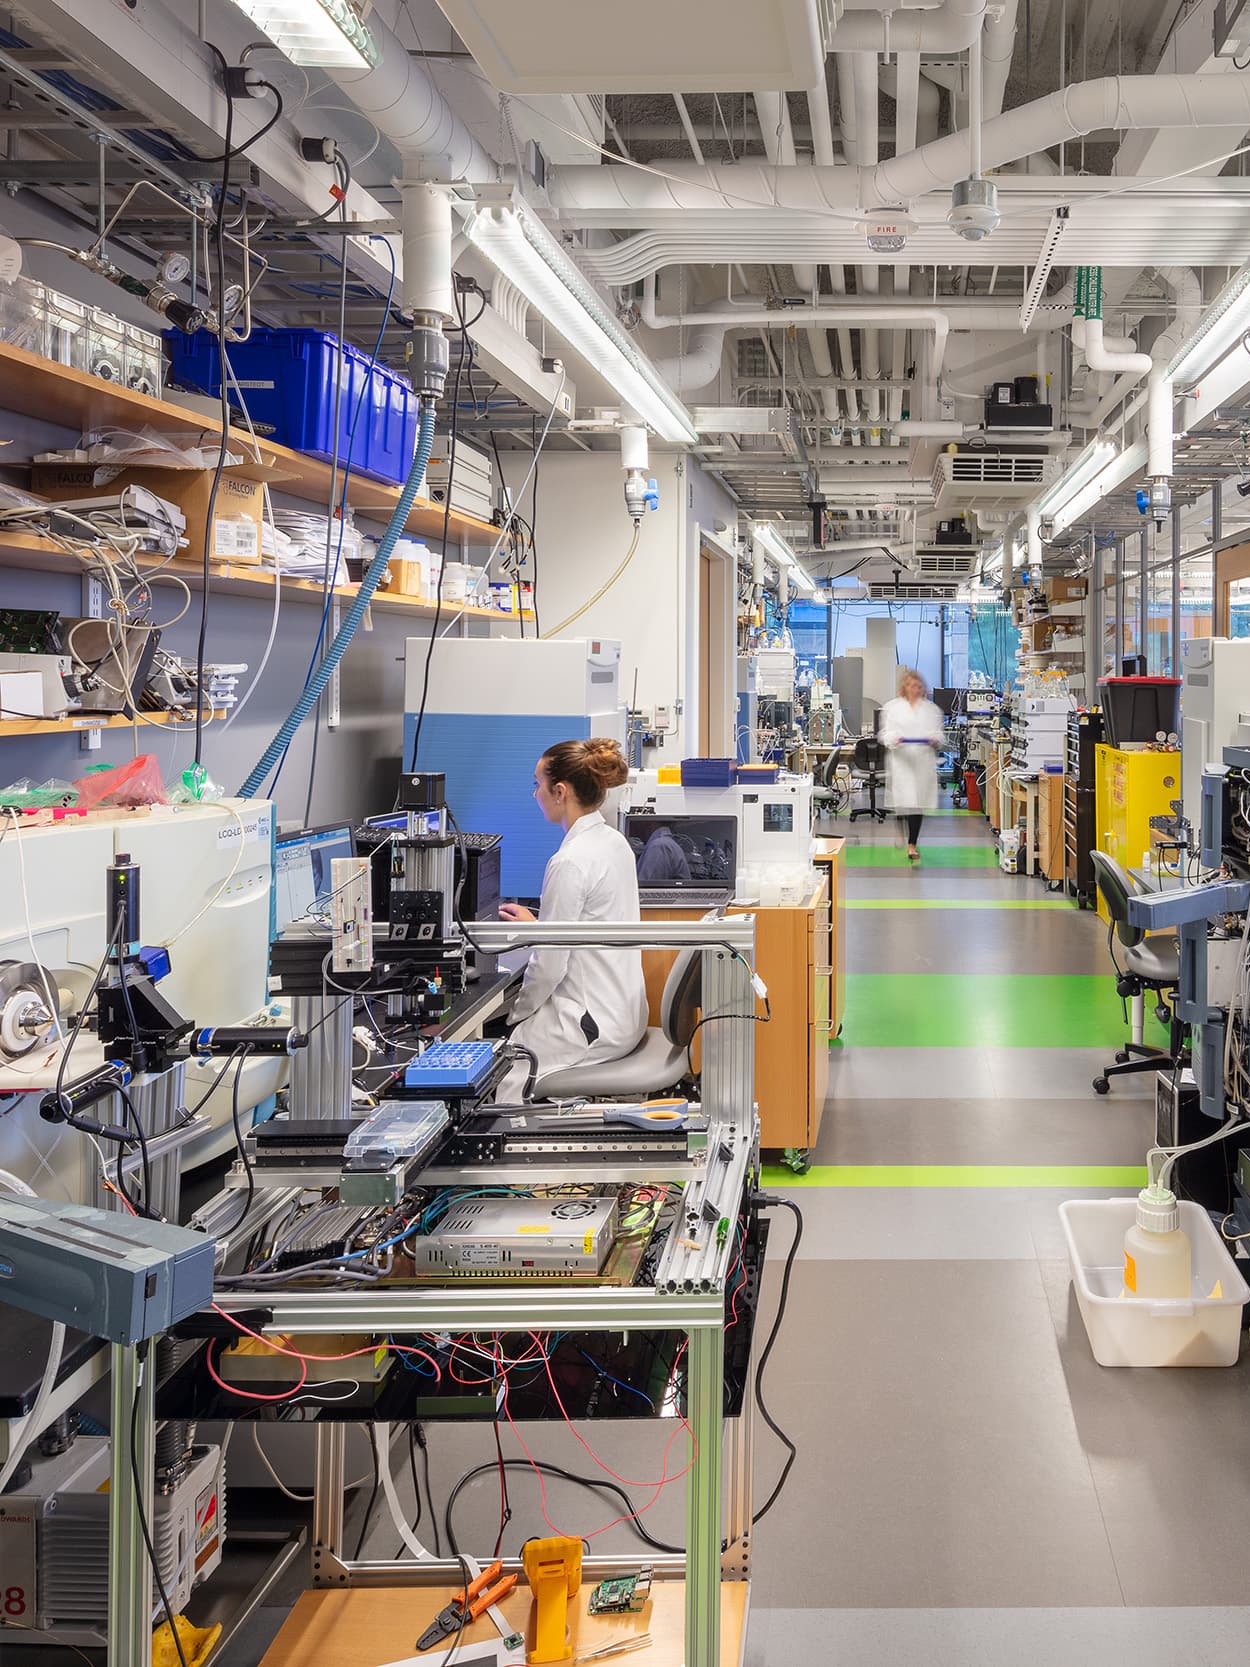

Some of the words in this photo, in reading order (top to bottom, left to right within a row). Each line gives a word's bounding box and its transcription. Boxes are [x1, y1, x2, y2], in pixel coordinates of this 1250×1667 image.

[56, 472, 94, 483] FALCO
[228, 480, 256, 496] FALCON
[0, 1515, 31, 1524] DWARDS
